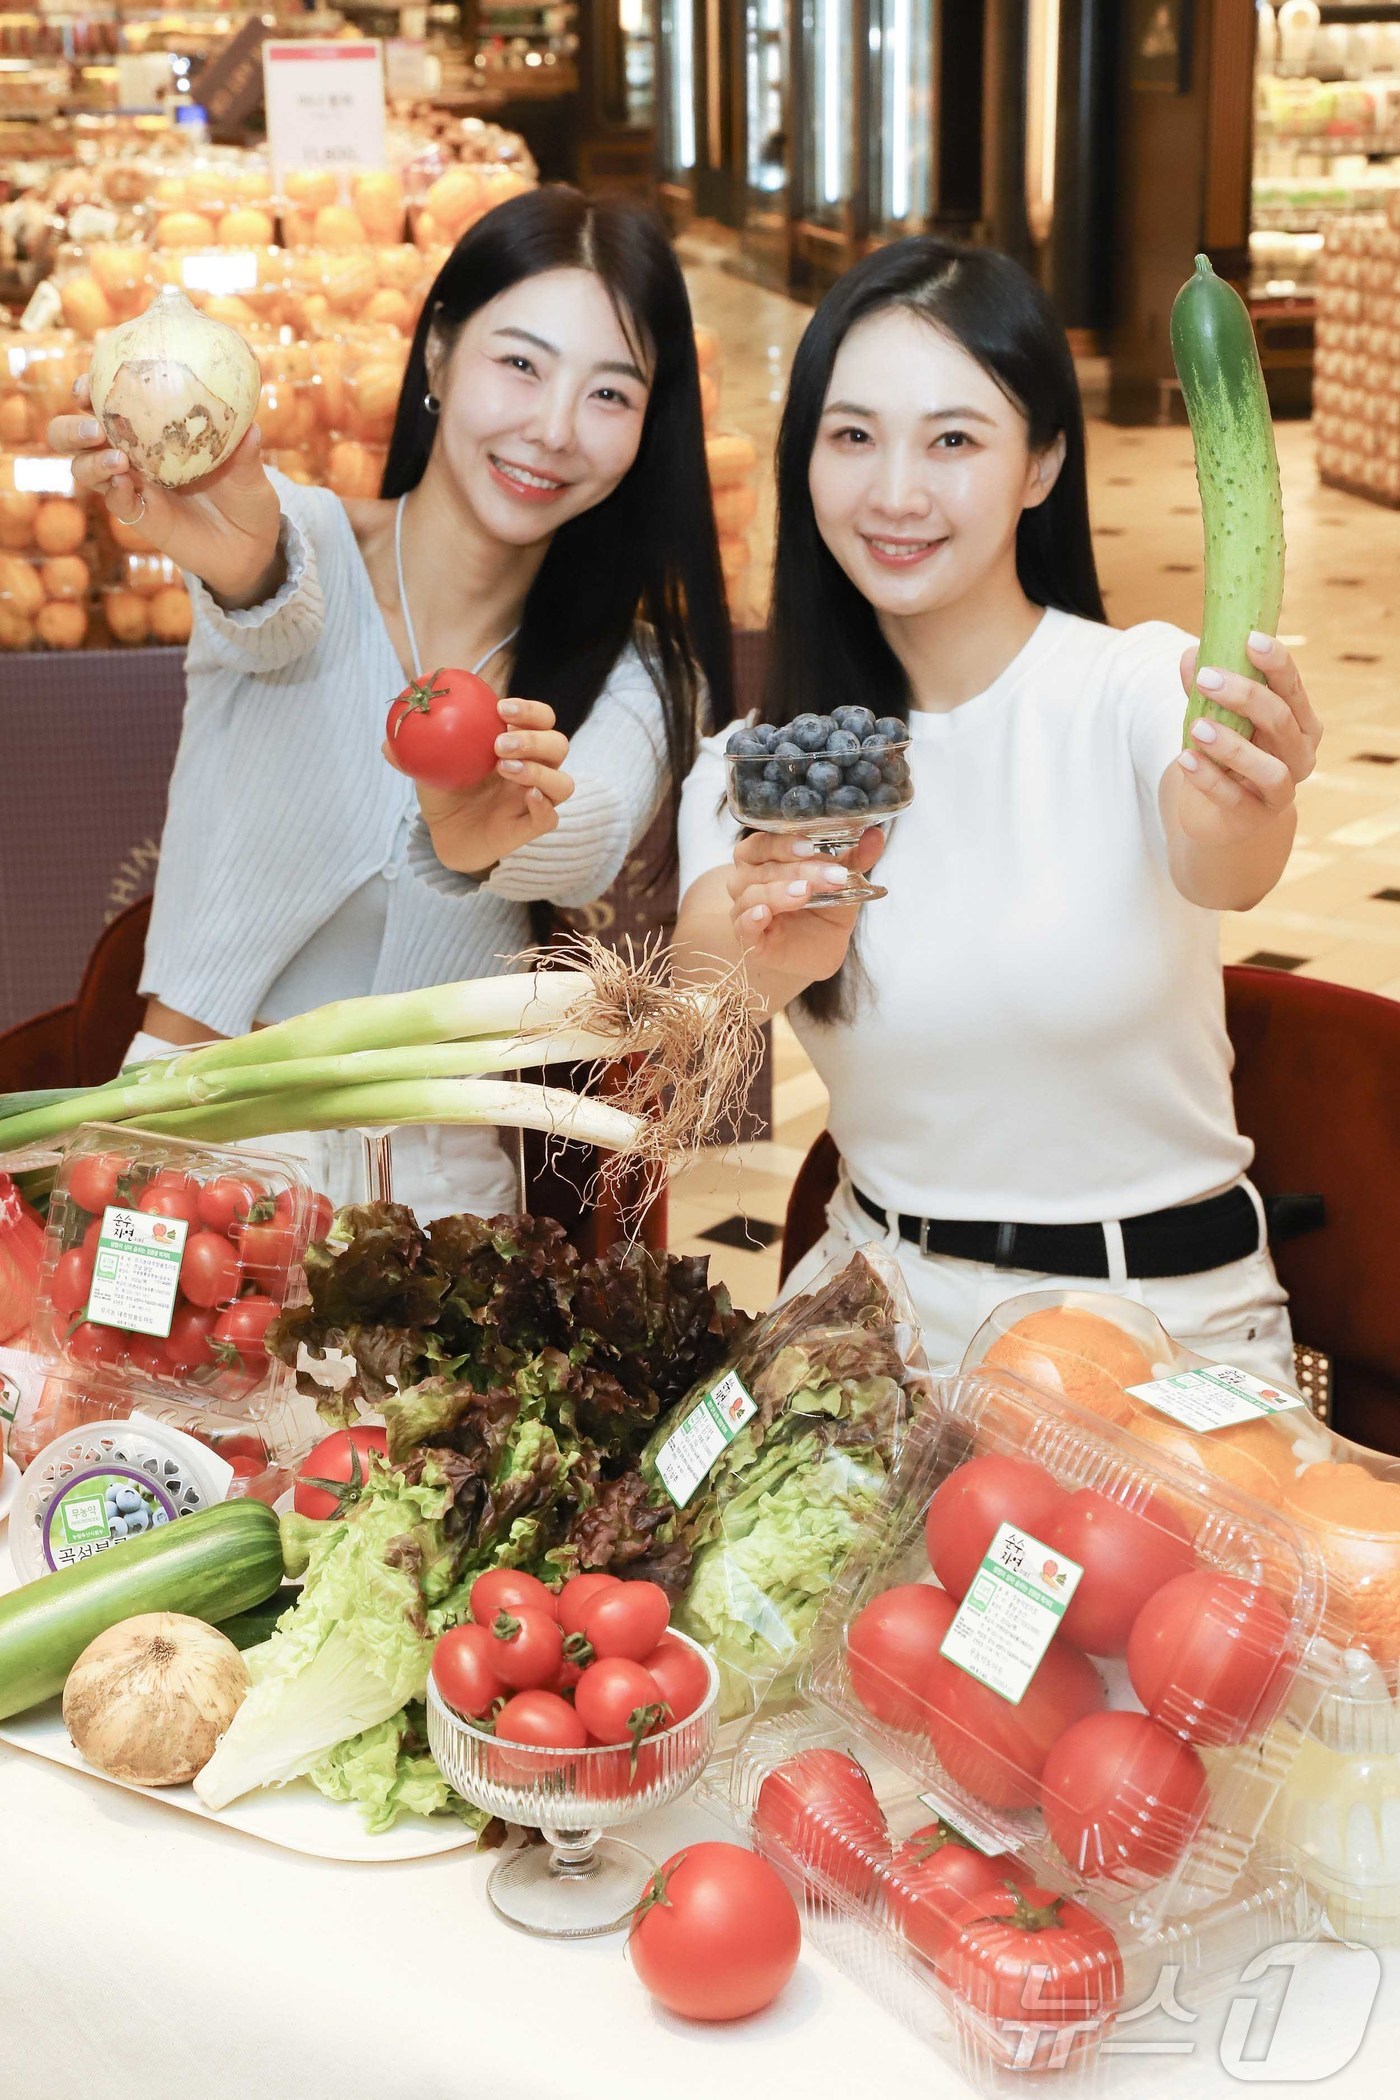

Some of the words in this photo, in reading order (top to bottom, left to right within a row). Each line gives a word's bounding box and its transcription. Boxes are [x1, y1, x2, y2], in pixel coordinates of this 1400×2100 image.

[113, 1213, 133, 1228] 순수
[113, 1228, 134, 1241] 자연
[72, 1505, 97, 1518] 무농약
[59, 1537, 127, 1564] 곡성
[1005, 1534, 1025, 1553] 순수
[1000, 1551, 1023, 1572] 자연
